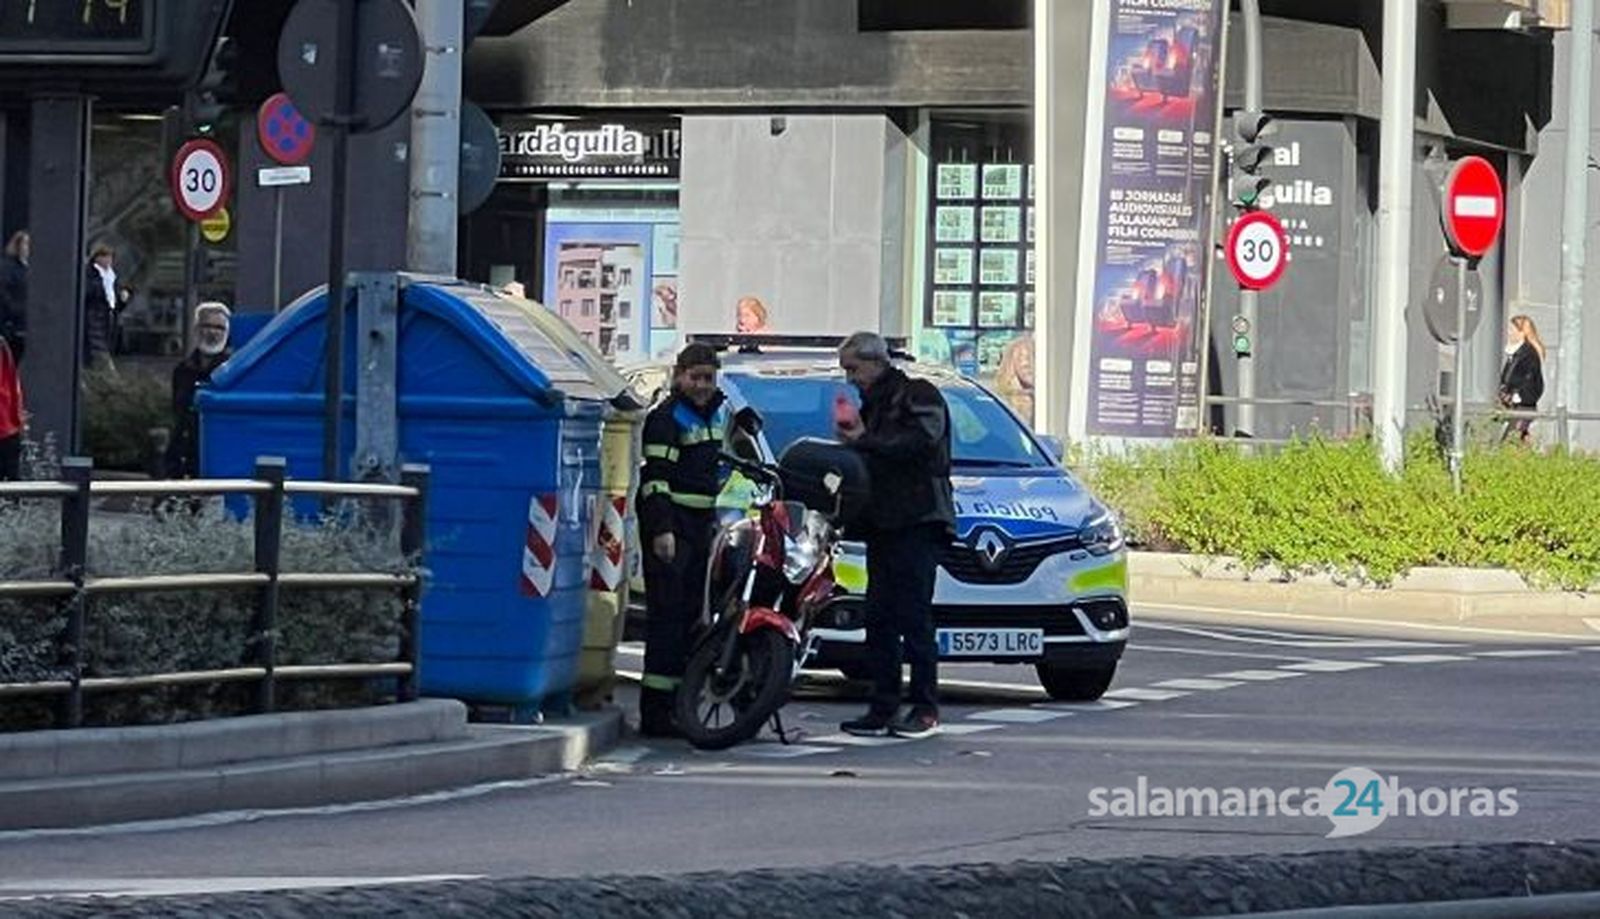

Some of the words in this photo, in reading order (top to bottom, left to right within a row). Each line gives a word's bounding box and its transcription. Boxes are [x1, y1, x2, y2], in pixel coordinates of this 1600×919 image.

[499, 122, 642, 163] ardáguila
[186, 168, 216, 193] 30
[1243, 239, 1274, 262] 30
[953, 632, 998, 650] 5573
[1005, 632, 1039, 650] LRC
